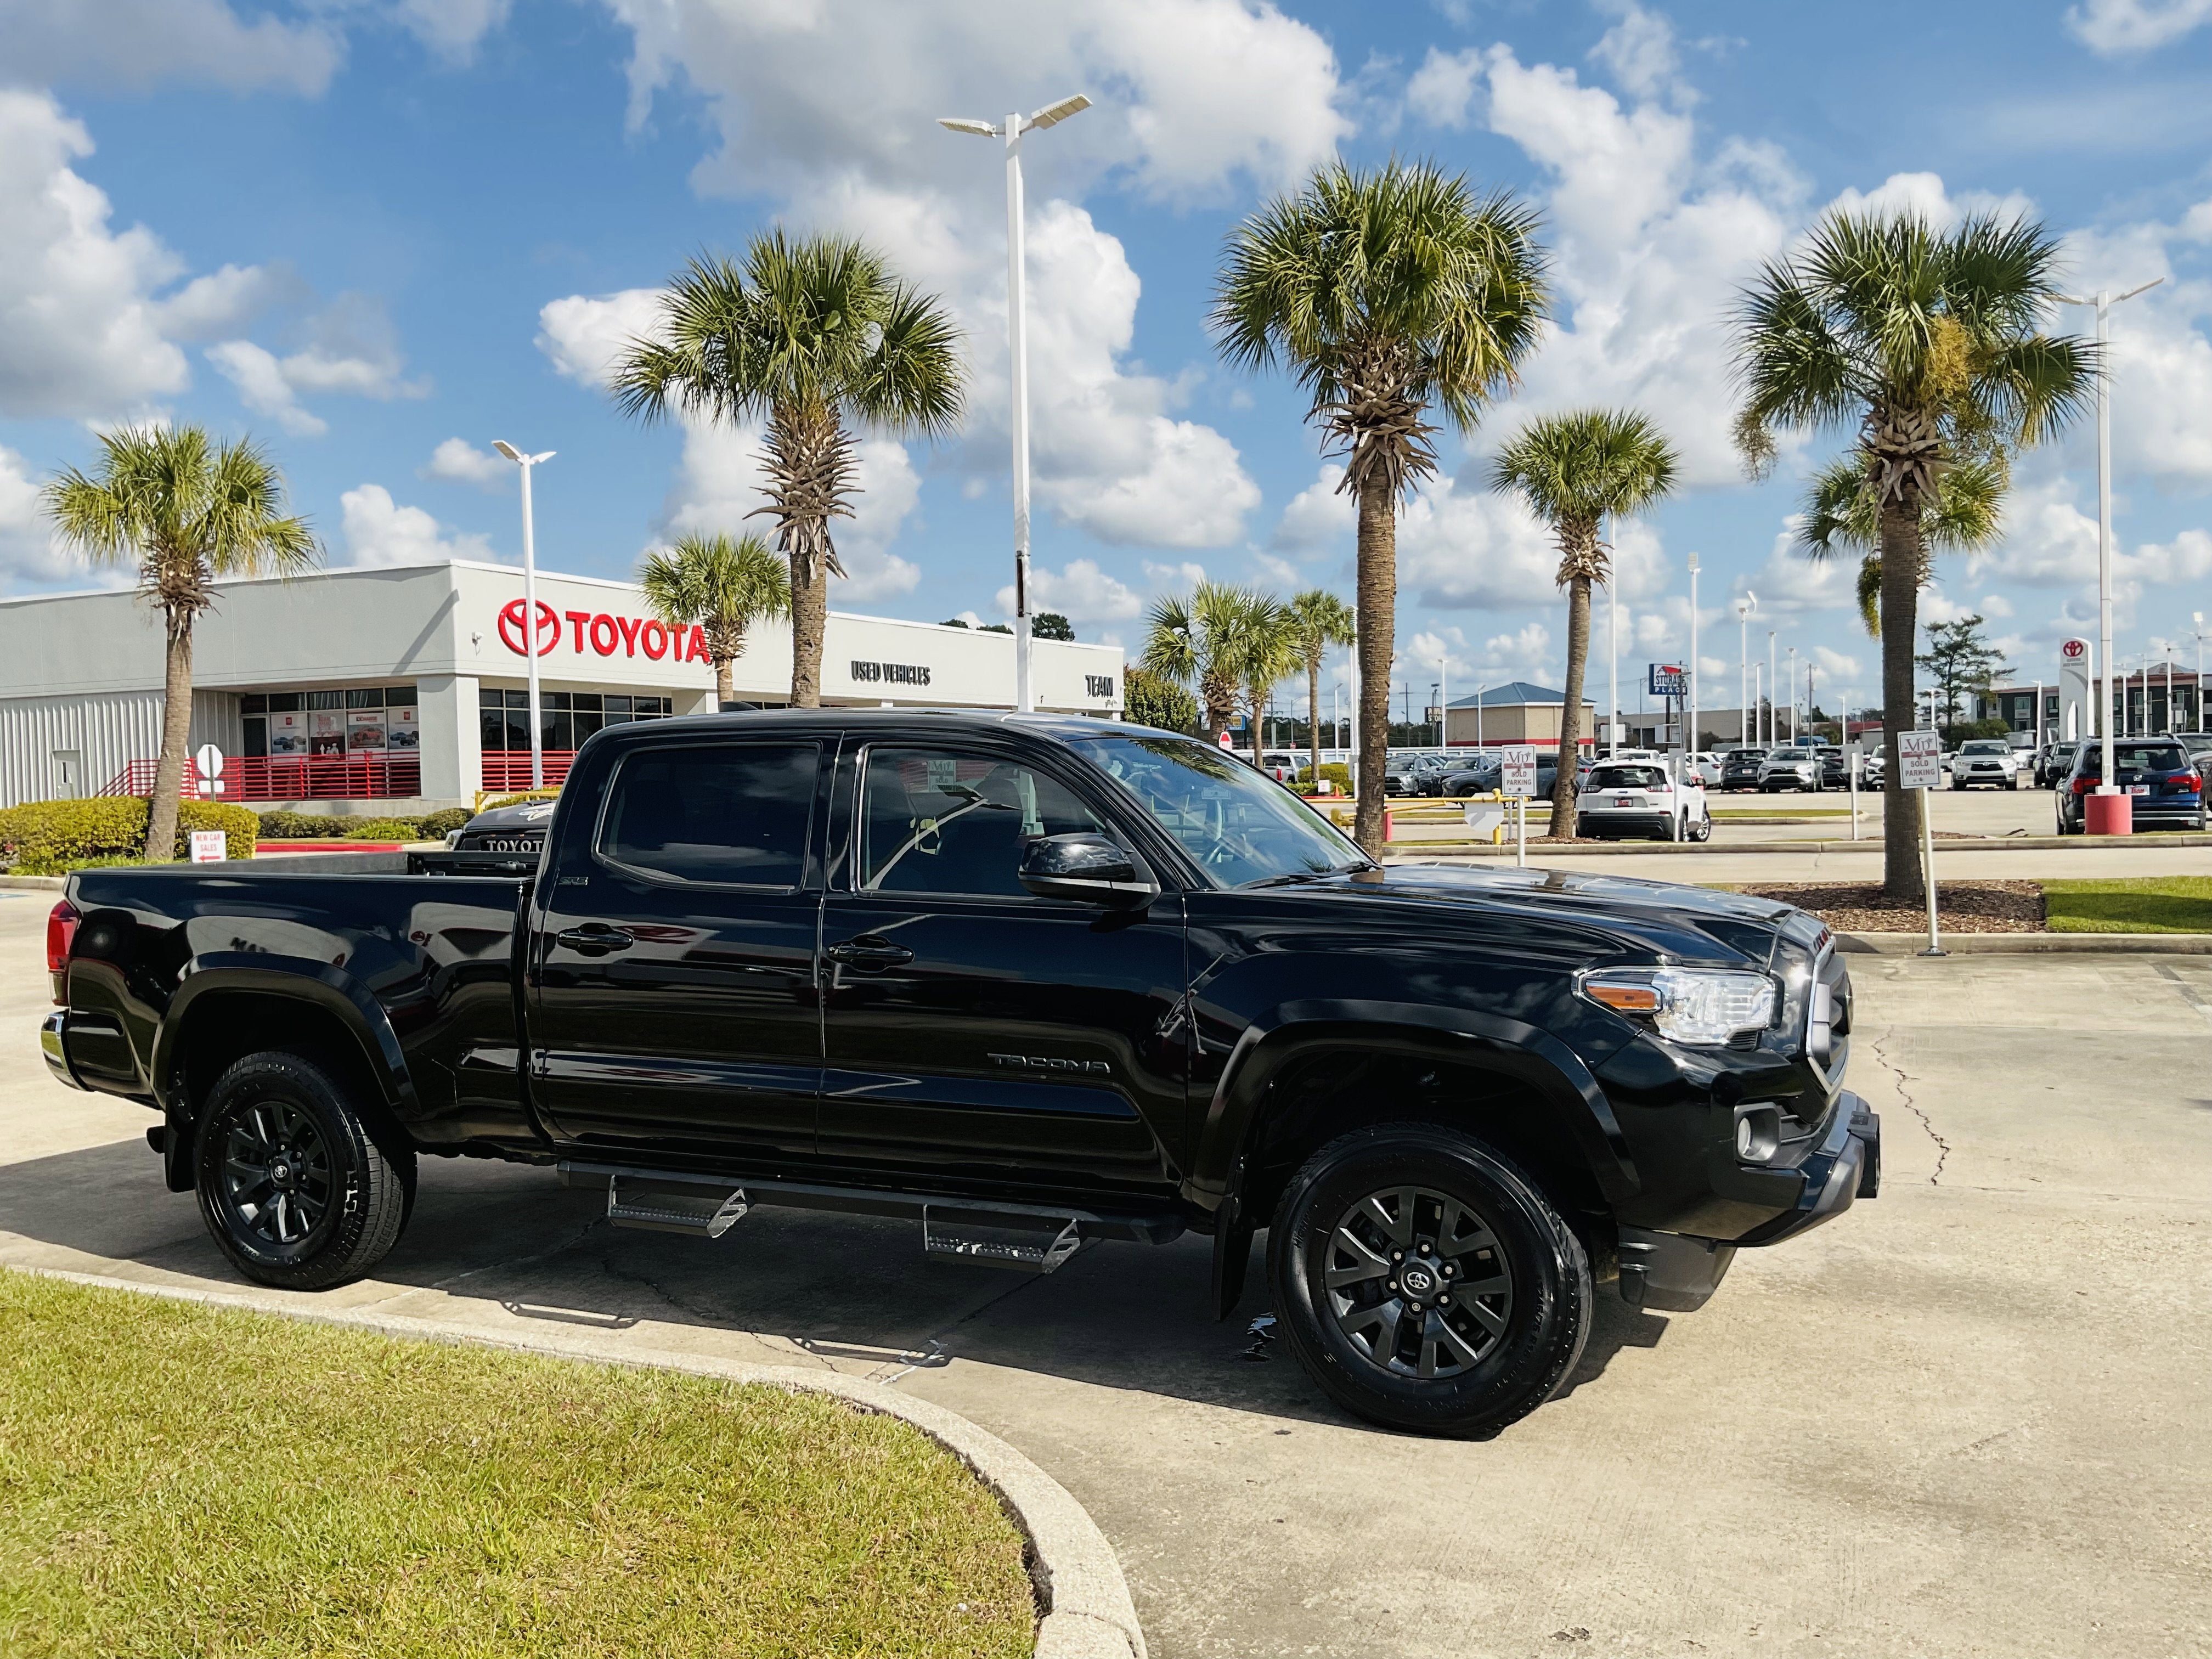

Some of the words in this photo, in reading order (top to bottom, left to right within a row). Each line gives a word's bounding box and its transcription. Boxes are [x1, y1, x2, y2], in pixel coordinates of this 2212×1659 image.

[565, 611, 712, 663] TOYOTA
[851, 660, 881, 682] USED
[882, 663, 930, 686] VEHICLES
[1085, 675, 1113, 698] TEAM
[1905, 769, 1935, 777] PARKING
[196, 833, 208, 842] NEW
[200, 843, 217, 851] SALES
[487, 840, 543, 852] TOYOT
[987, 1053, 1110, 1074] TACOMA
